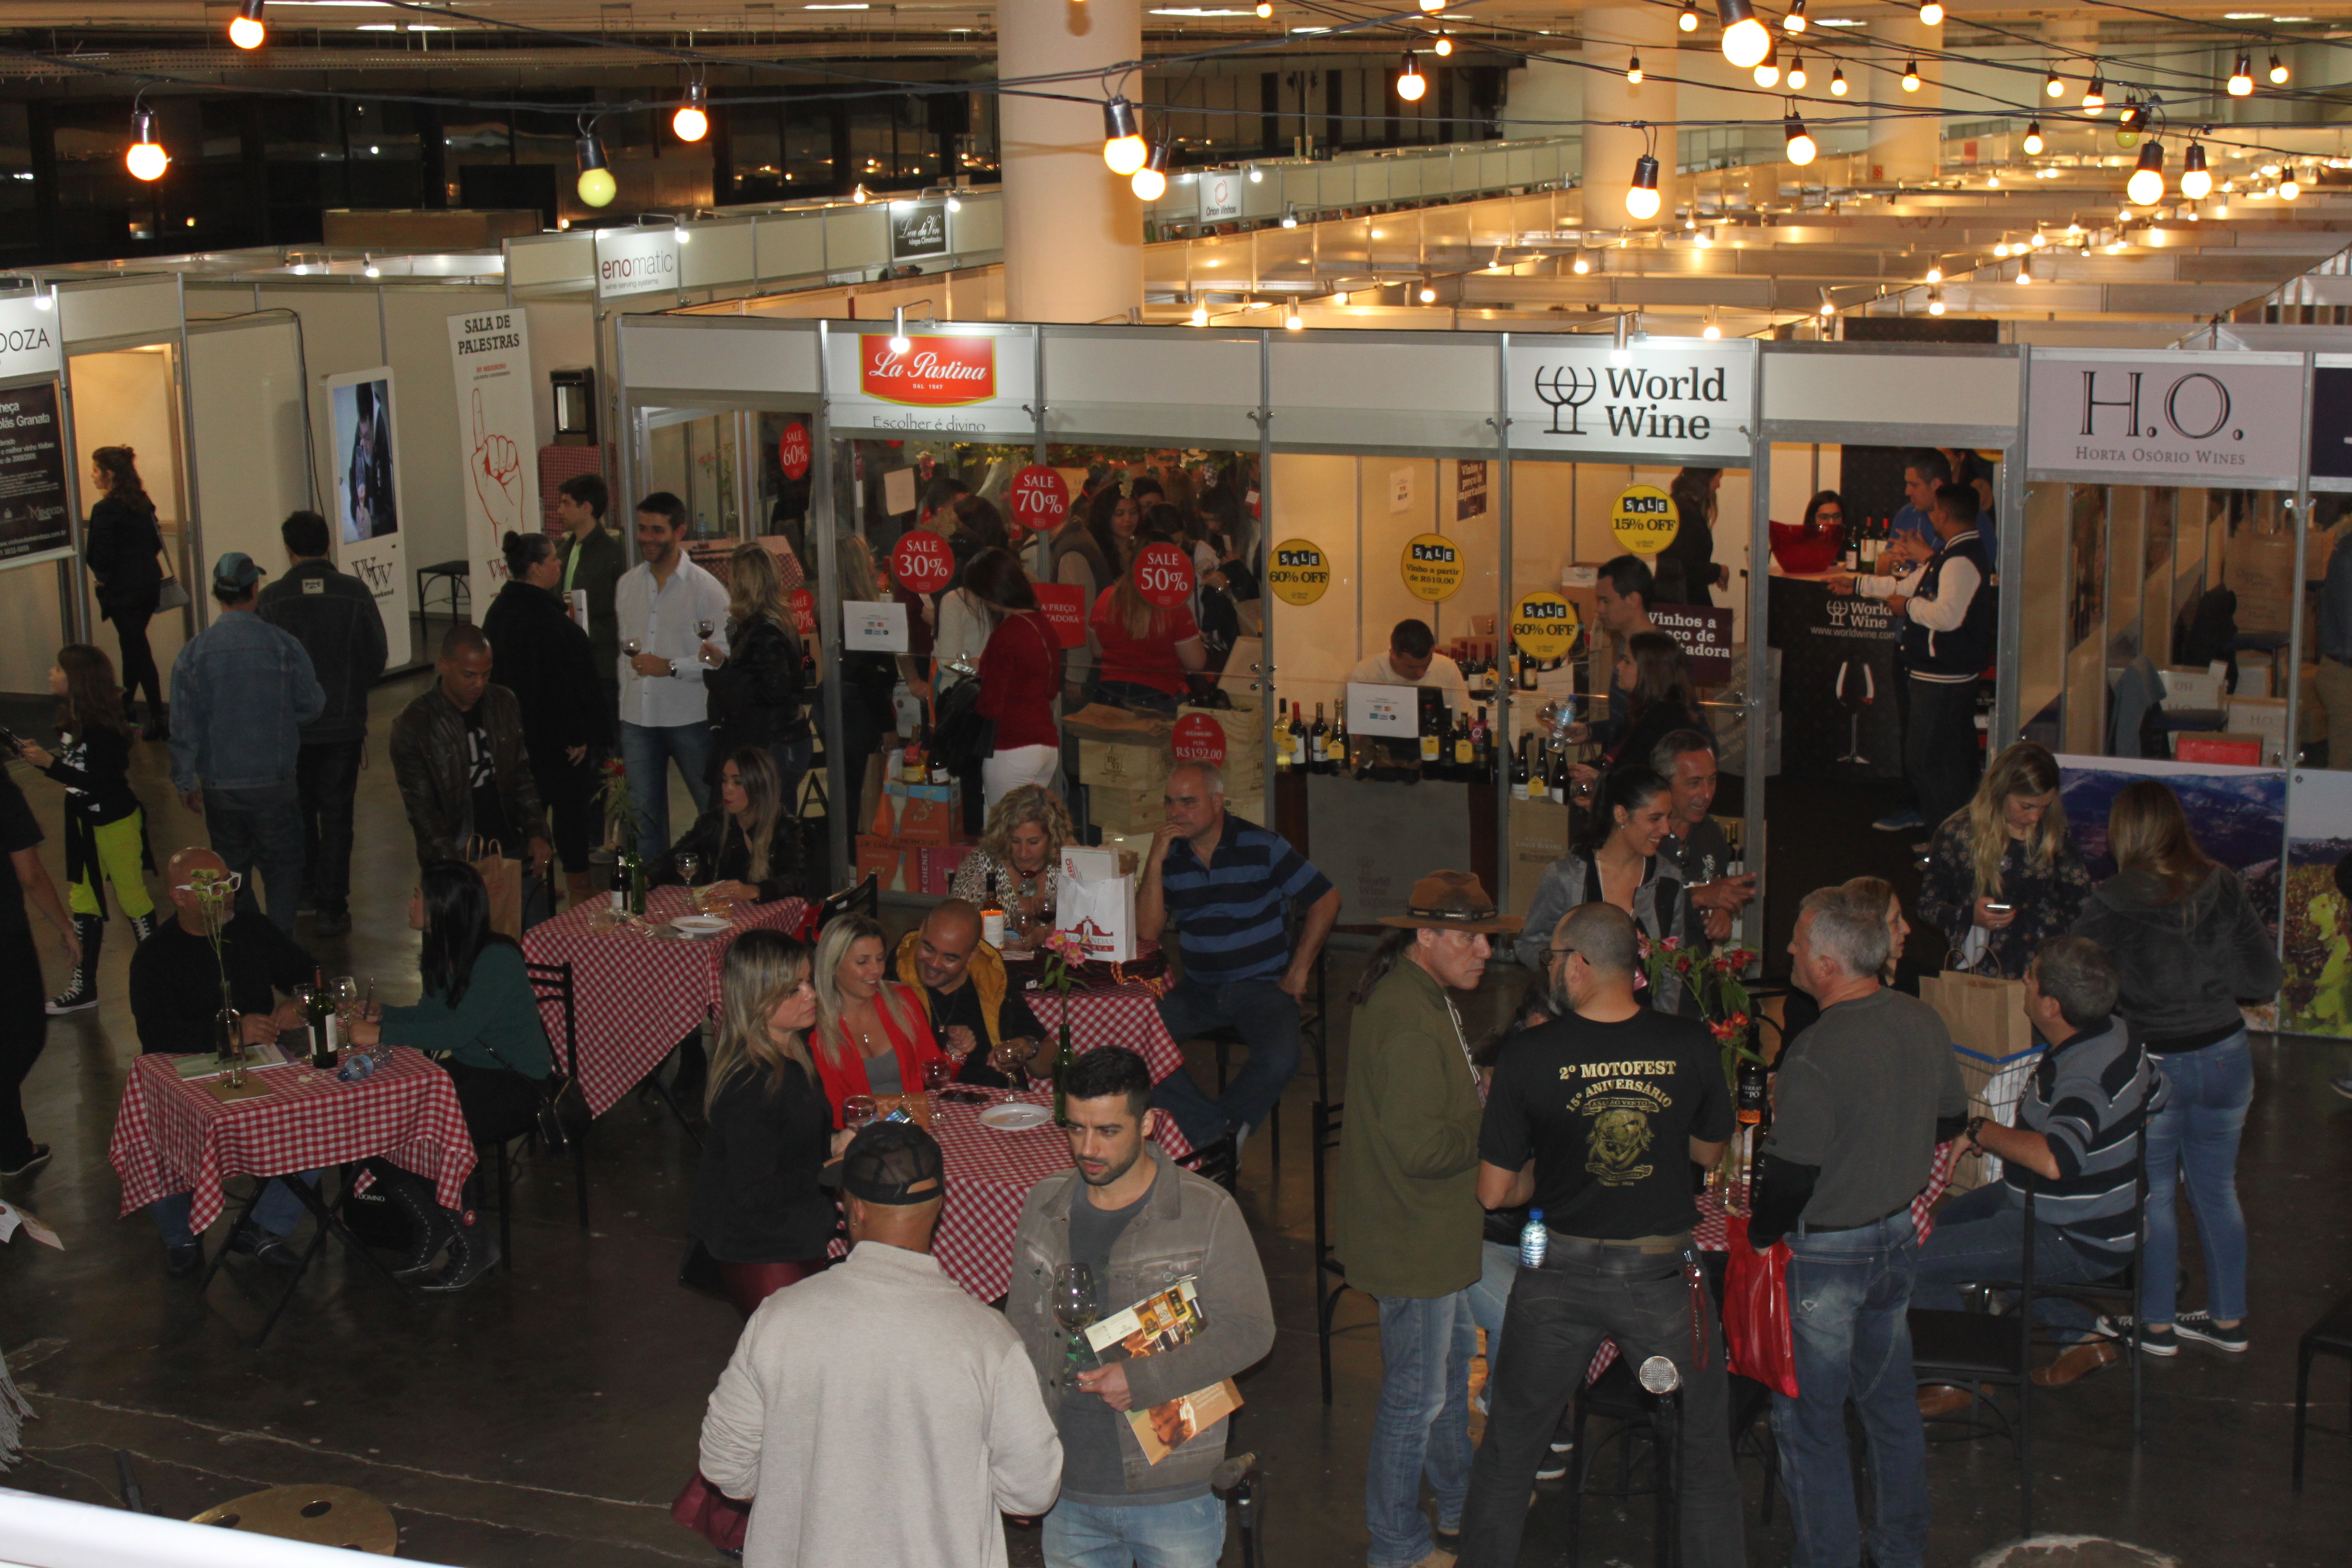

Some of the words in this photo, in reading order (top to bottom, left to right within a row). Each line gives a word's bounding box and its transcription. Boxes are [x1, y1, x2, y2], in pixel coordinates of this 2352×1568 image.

[1206, 206, 1219, 216] Orion
[1220, 205, 1236, 214] Vinhos
[927, 214, 940, 236] Vin
[601, 250, 673, 280] enomatic
[637, 278, 658, 287] systems
[465, 317, 493, 334] SALA
[496, 314, 511, 330] DE
[458, 333, 520, 355] PALESTRAS
[869, 351, 903, 377] La
[907, 351, 987, 380] Pastina
[1604, 366, 1728, 402] World
[2079, 371, 2244, 439] H.O.
[16, 413, 50, 426] Granata
[873, 412, 931, 430] Escolher
[935, 418, 943, 431] é
[946, 415, 985, 432] divino
[1604, 404, 1711, 440] Wine
[786, 430, 802, 443] SALE
[783, 445, 807, 466] 60%
[1024, 475, 1054, 488] SALE
[1017, 490, 1063, 514] 70%
[1624, 498, 1666, 512] SALE
[1614, 518, 1644, 530] 15%
[1647, 519, 1676, 531] OFF
[906, 540, 938, 552] SALE
[1147, 553, 1178, 565] SALE
[1280, 552, 1319, 565] SALE
[1414, 546, 1453, 561] SALE
[899, 554, 948, 577] 30%
[1407, 564, 1428, 573] Vinho
[1141, 568, 1188, 591] 50%
[1270, 571, 1298, 582] 60%
[1301, 571, 1328, 583] OFF
[1421, 576, 1454, 585] R$19,00
[373, 588, 394, 598] eekend
[1049, 604, 1076, 613] PREÇO
[1524, 604, 1565, 617] SALE
[1649, 612, 1703, 627] Vinhos
[1707, 619, 1716, 629] a
[1850, 615, 1888, 629] Wine
[1514, 624, 1544, 635] 60%
[1546, 624, 1575, 636] OFF
[1696, 630, 1715, 642] de
[1176, 747, 1222, 760] R$192.00
[1559, 1065, 1576, 1080] 2º
[1580, 1061, 1677, 1078] MOTOFEST
[1566, 1092, 1582, 1112] 15º
[1585, 1078, 1672, 1108] ANIVERSÁRIO
[1749, 1090, 1760, 1098] PÓ
